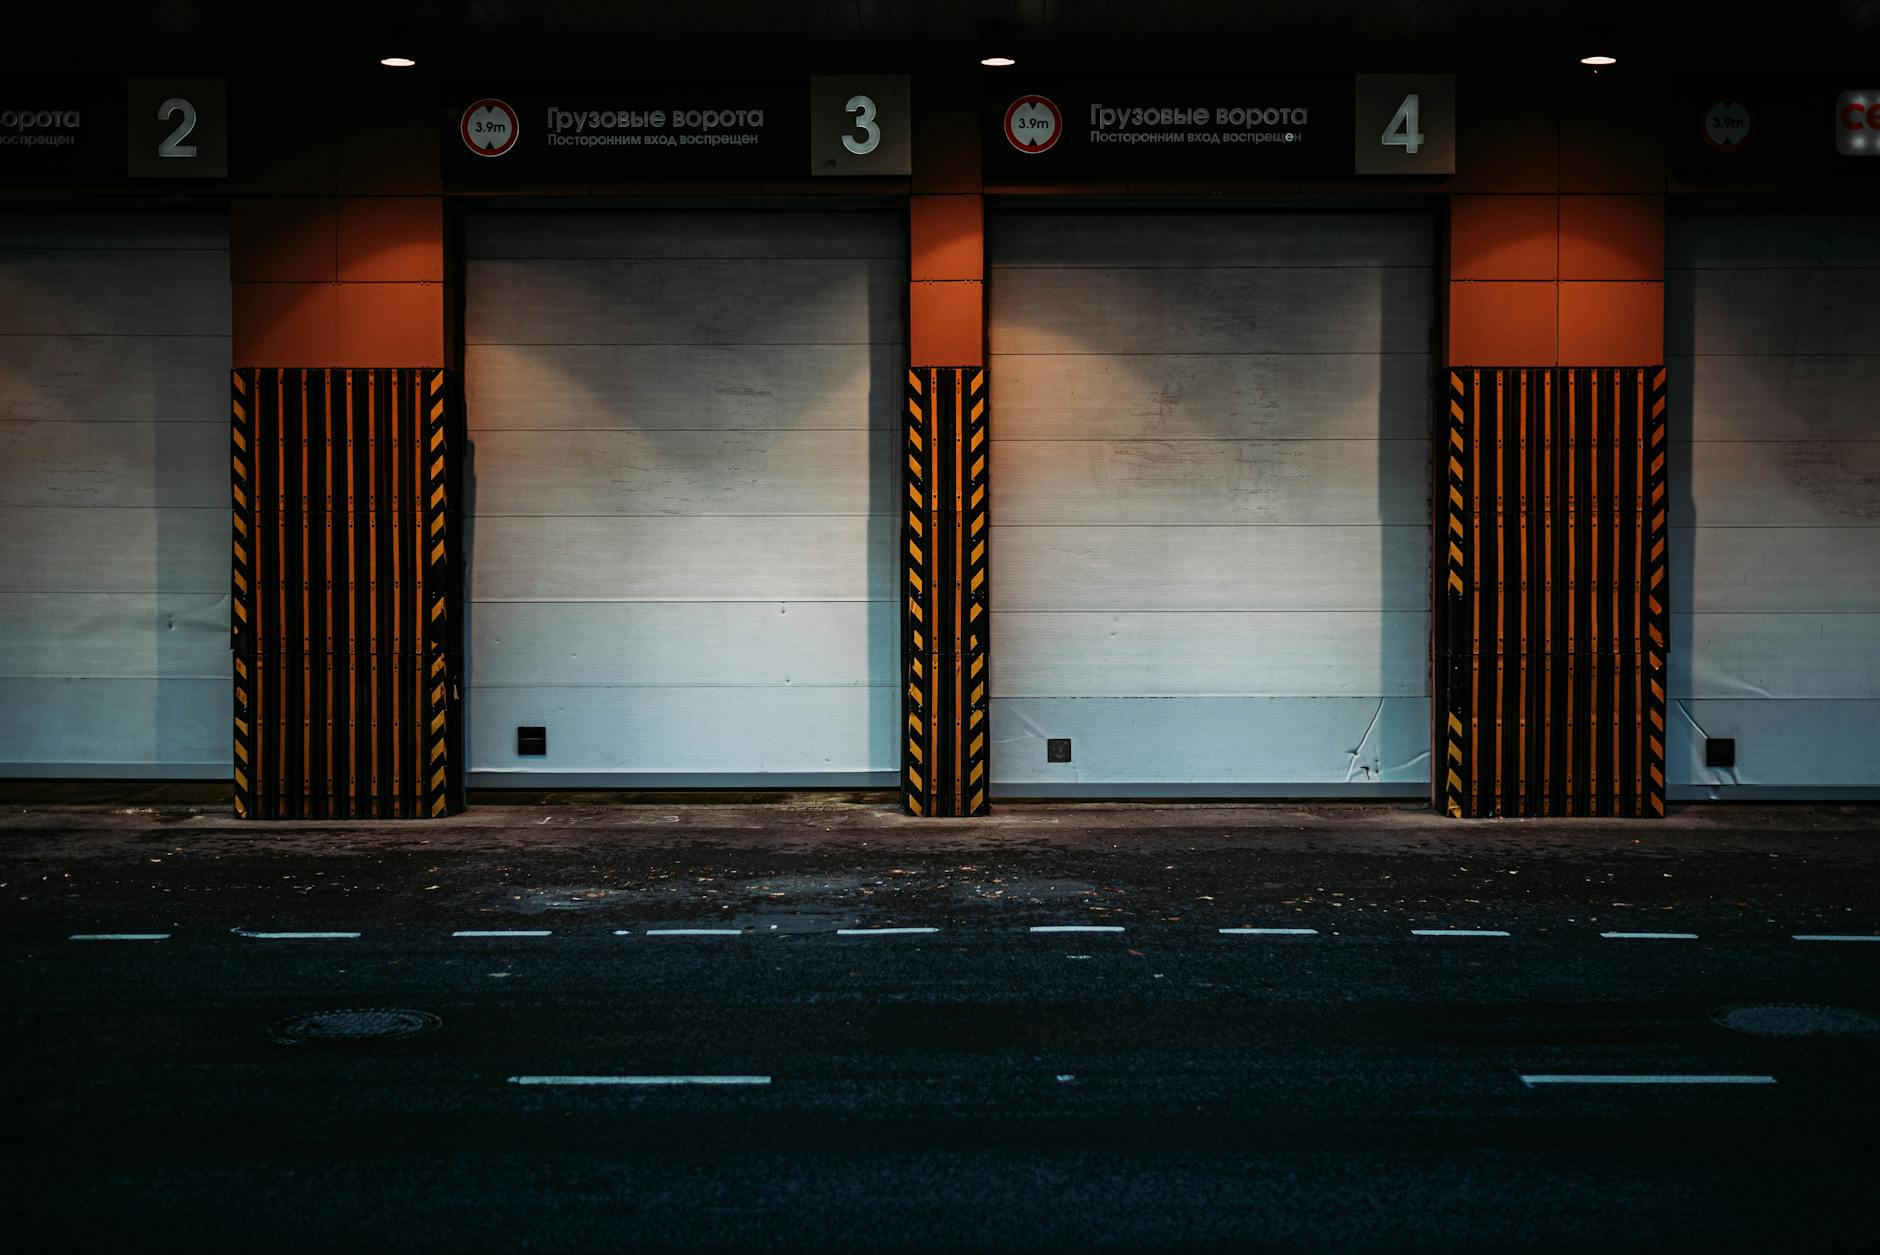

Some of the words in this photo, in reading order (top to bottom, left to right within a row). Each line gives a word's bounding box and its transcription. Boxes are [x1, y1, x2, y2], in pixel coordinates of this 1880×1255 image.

[0, 110, 81, 131] орота
[475, 121, 506, 133] 3.9m
[547, 107, 667, 130] Грузовые
[672, 109, 765, 130] ворота
[841, 95, 881, 155] 3
[1018, 118, 1050, 130] 3.9m
[1090, 104, 1211, 128] Грузовые
[1215, 106, 1308, 128] ворота
[1381, 94, 1424, 154] 4
[157, 98, 197, 158] 2
[1090, 131, 1185, 145] Посторонним
[1187, 132, 1221, 145] вход
[1222, 131, 1302, 145] воспрещен
[547, 134, 642, 147] Посторонним
[643, 135, 678, 147] вход
[679, 134, 759, 147] воспрещен
